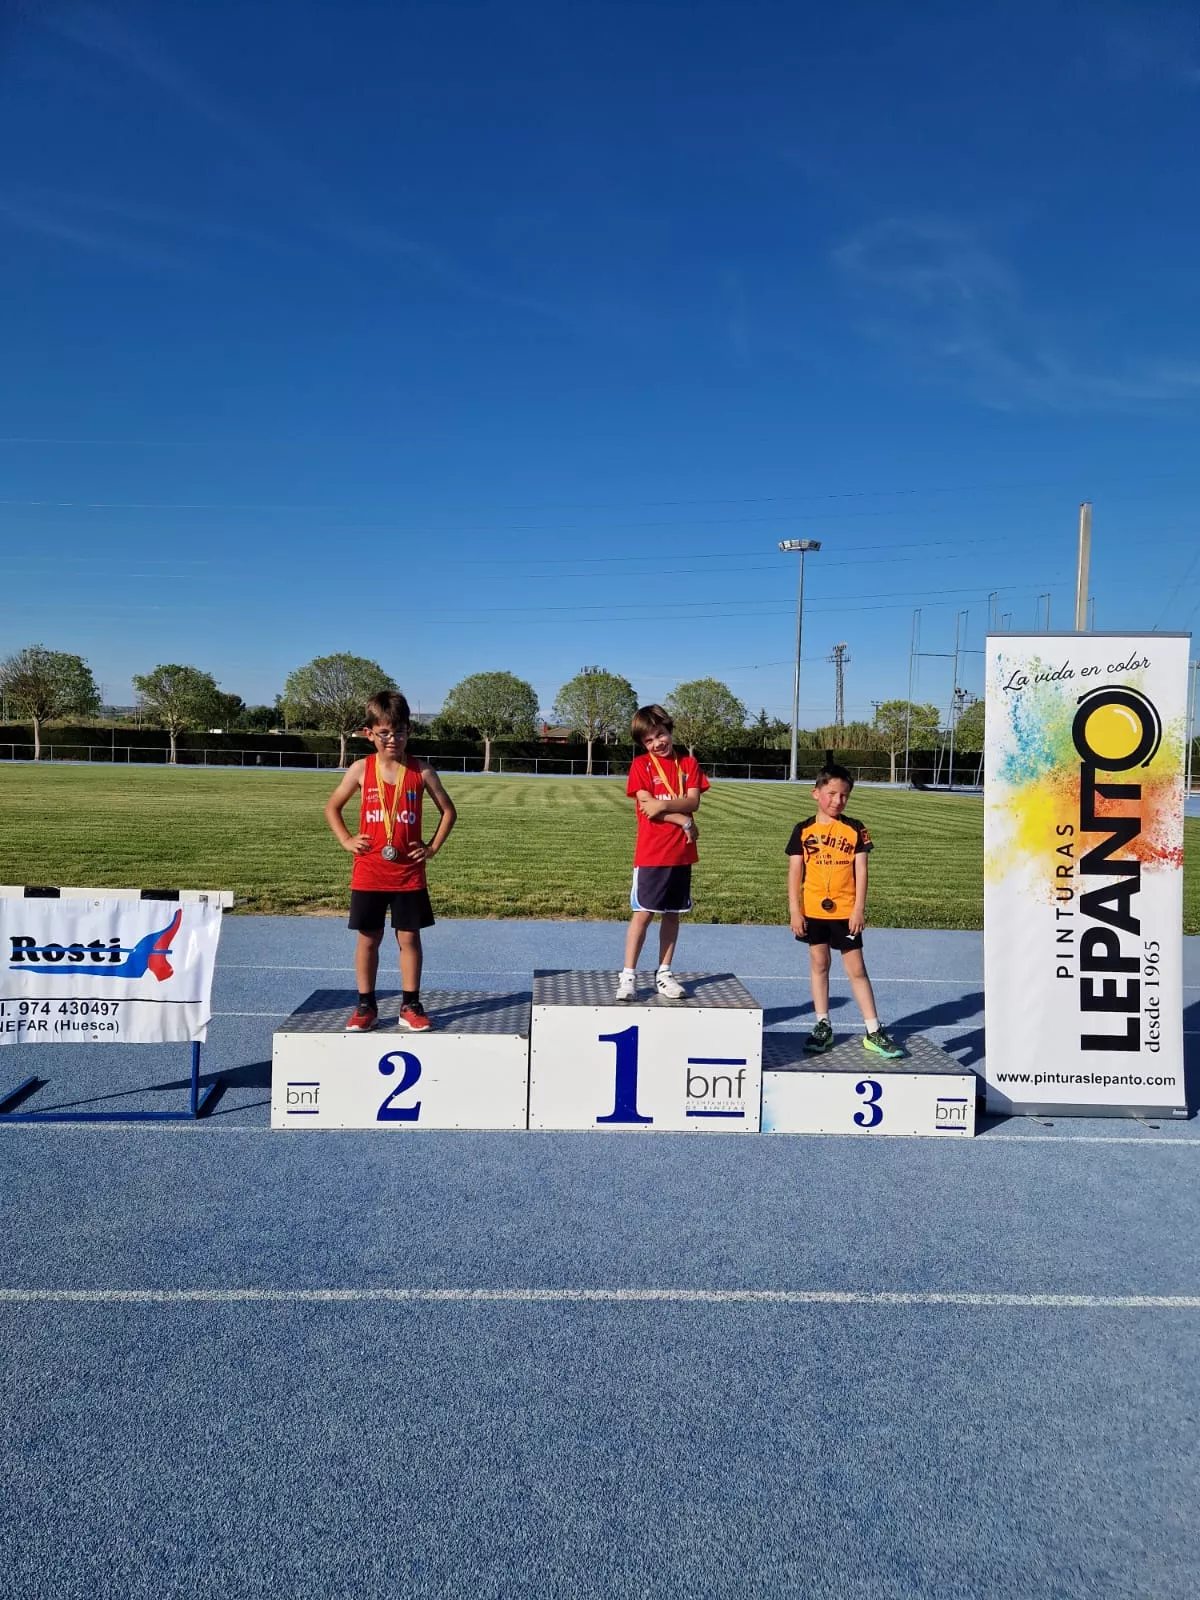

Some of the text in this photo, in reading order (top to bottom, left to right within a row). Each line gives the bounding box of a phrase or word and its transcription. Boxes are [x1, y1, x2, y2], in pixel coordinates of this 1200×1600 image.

[1002, 651, 1152, 691] La vida en color
[1072, 685, 1162, 1052] LEPANTO
[1056, 824, 1074, 979] PINTURAS
[9, 936, 122, 963] Rosti
[19, 1001, 51, 1015] 974
[58, 1001, 119, 1016] 430497
[1144, 940, 1160, 1053] desde 1965
[54, 1019, 119, 1034] (Huesca)
[376, 1050, 422, 1121] 2
[596, 1025, 653, 1123] 1
[686, 1068, 746, 1098] bnf
[996, 1072, 1176, 1087] www.pinturaslepanto.com
[286, 1087, 320, 1105] bnf
[853, 1080, 883, 1127] 3
[935, 1103, 968, 1121] bnf
